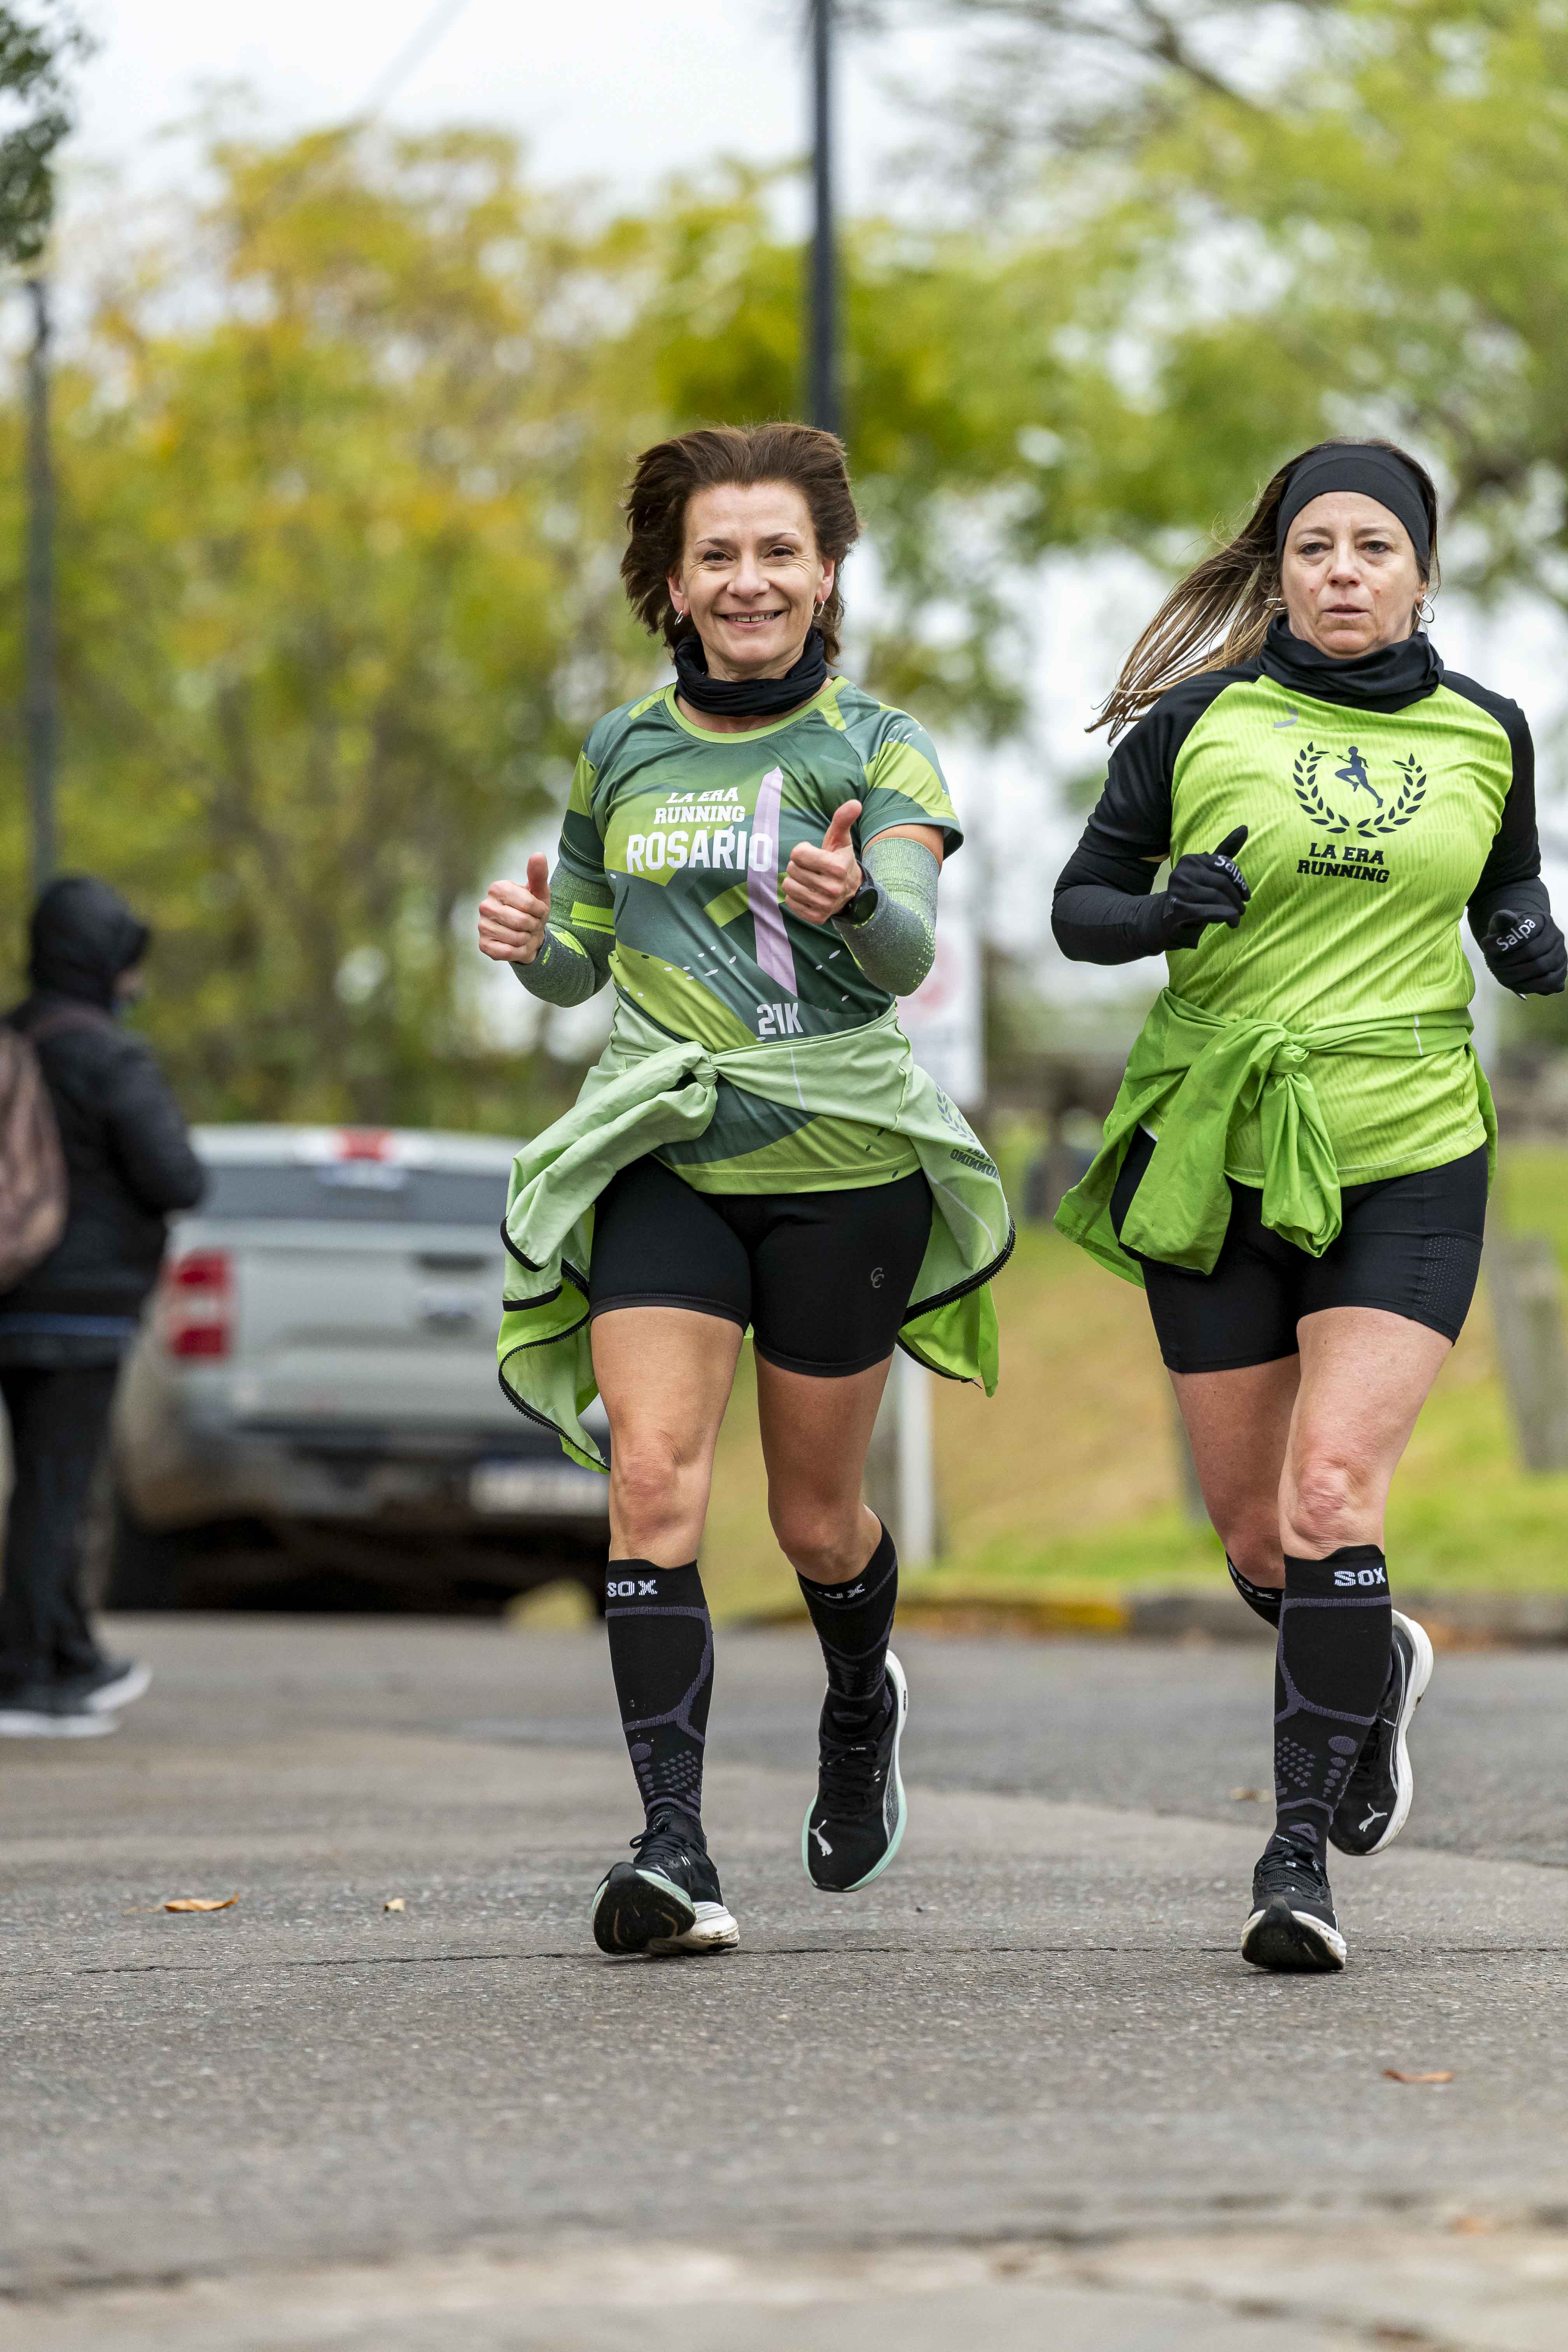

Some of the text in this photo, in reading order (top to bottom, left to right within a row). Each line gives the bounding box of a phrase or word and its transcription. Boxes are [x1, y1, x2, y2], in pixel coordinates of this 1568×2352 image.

[666, 787, 738, 803] LA ERA
[653, 806, 746, 824] RUNNING
[626, 829, 773, 873] ROSARIO
[1309, 842, 1384, 865] LA ERA
[1297, 859, 1390, 883] RUNNING
[1496, 919, 1536, 951] Salpa
[757, 1003, 804, 1035] 21K
[1334, 1567, 1386, 1586] SOX
[607, 1580, 658, 1597] SOX
